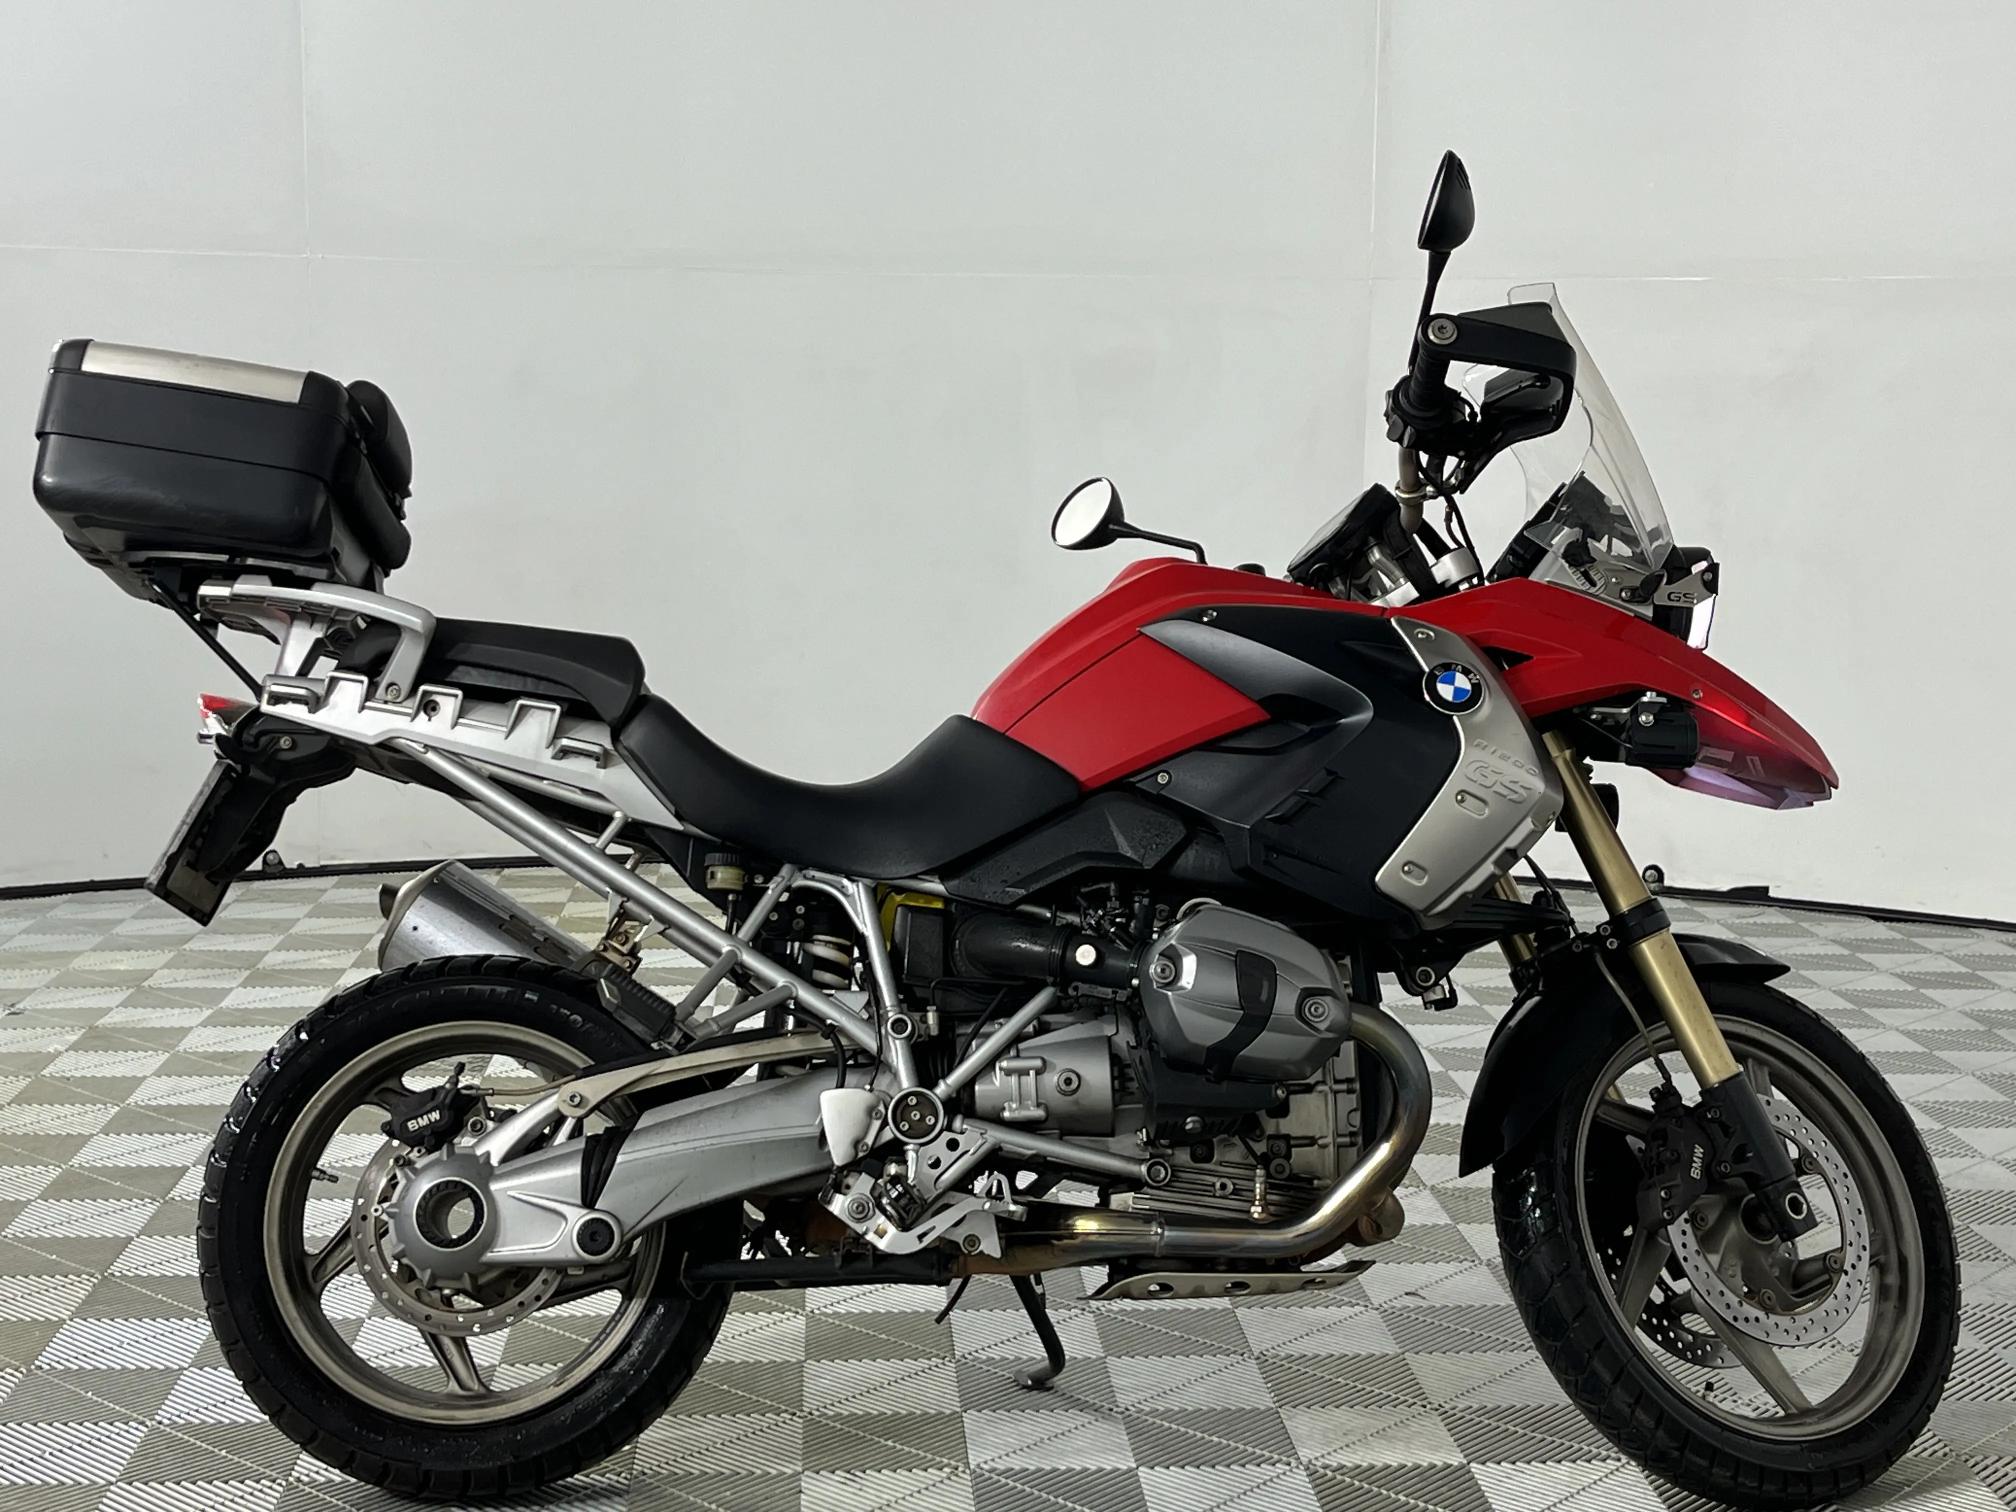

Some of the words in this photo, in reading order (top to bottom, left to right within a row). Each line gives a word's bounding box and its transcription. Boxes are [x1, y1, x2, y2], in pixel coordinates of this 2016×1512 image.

[1667, 591, 1697, 604] GS
[1433, 663, 1480, 684] BMW
[1465, 760, 1534, 805] GS
[406, 1109, 440, 1131] BMW
[1690, 1143, 1704, 1180] BMW
